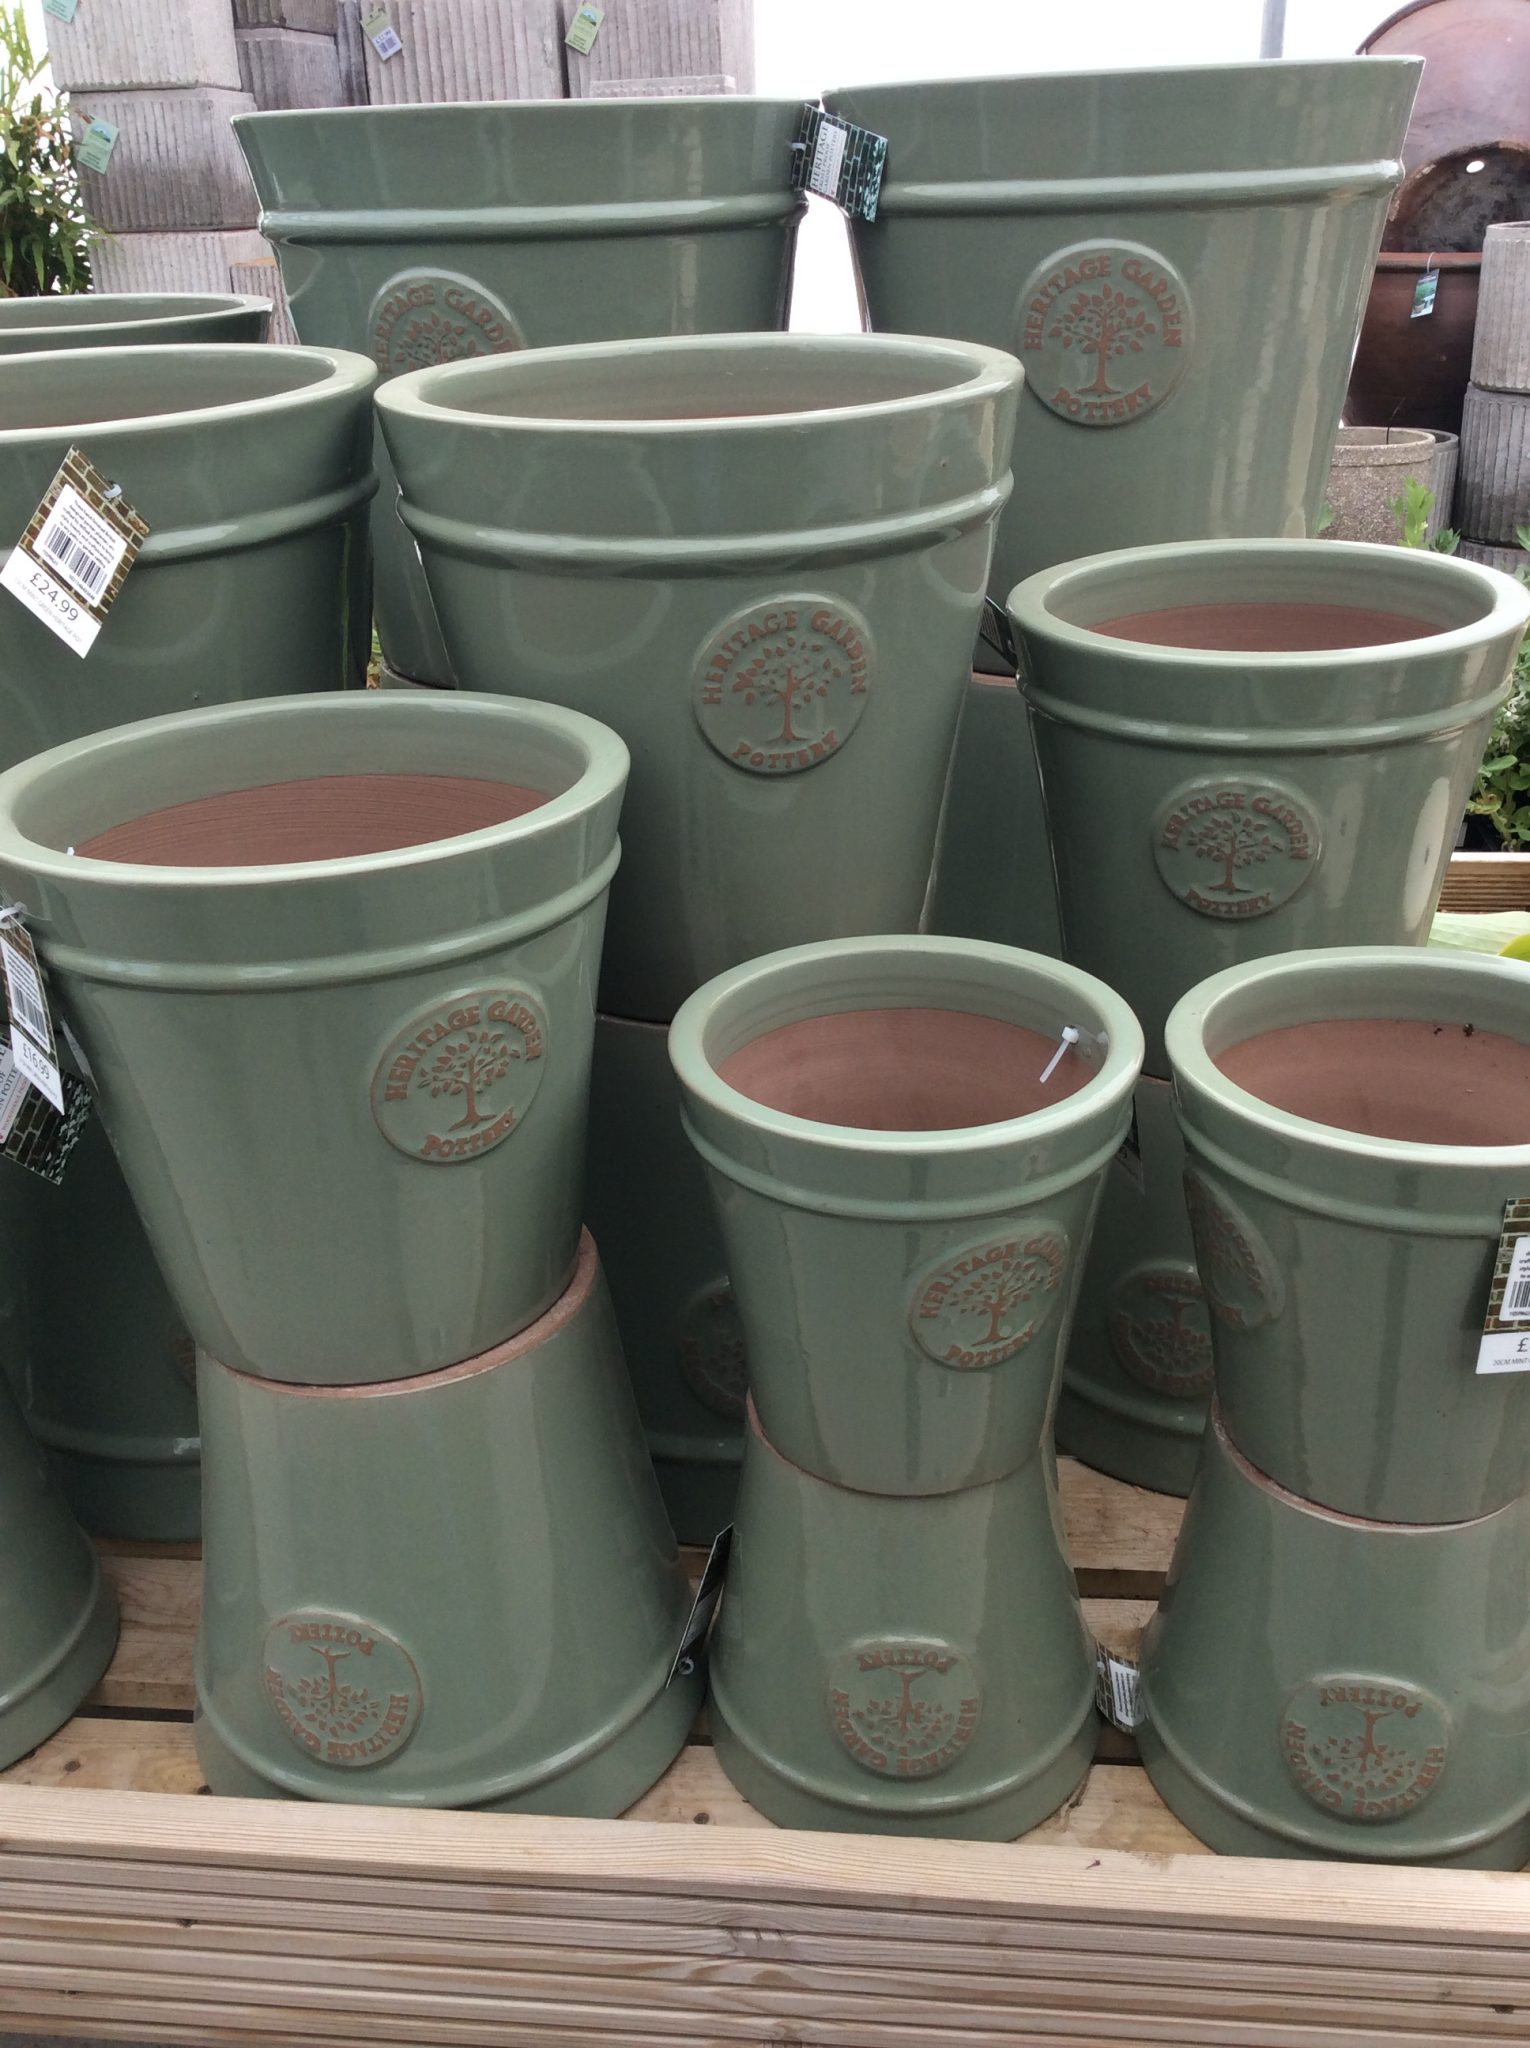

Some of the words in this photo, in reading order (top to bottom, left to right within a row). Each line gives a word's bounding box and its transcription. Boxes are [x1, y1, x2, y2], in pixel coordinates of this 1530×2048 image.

[811, 126, 829, 188] HERITAGE
[375, 284, 436, 374] HERITAGE
[444, 289, 515, 354] GARDE
[1024, 255, 1111, 349] HERITAGE
[1121, 258, 1183, 348] GARDEN
[1051, 382, 1153, 418] POTTERY
[29, 572, 79, 622] £24.99
[702, 610, 798, 705] HERITAGE
[811, 610, 867, 696] GARDEN
[731, 728, 838, 769] POTTERY
[1161, 791, 1246, 851] HERITAGE
[1252, 796, 1310, 860] GARDEN
[1183, 888, 1272, 914] POTTERY
[22, 1043, 50, 1080] £16.99
[384, 1005, 481, 1101] HERITAGE
[487, 1000, 543, 1062] GARDEN
[419, 1107, 516, 1157] POTTERY
[919, 1241, 1019, 1319] HERITAGE
[1023, 1238, 1065, 1292] GARDEN
[943, 1326, 1035, 1368] POTTERY
[288, 1622, 378, 1657] POTTERY
[857, 1648, 959, 1675] POTTERY
[265, 1664, 322, 1752] GARDEN
[327, 1694, 409, 1760] HERITAGE
[831, 1688, 888, 1769] GARDEN
[1319, 1685, 1423, 1719] POTTERY
[896, 1699, 979, 1773] HERITAGE
[1286, 1719, 1342, 1809] GARDEN
[1352, 1746, 1445, 1817] HERITAGE
